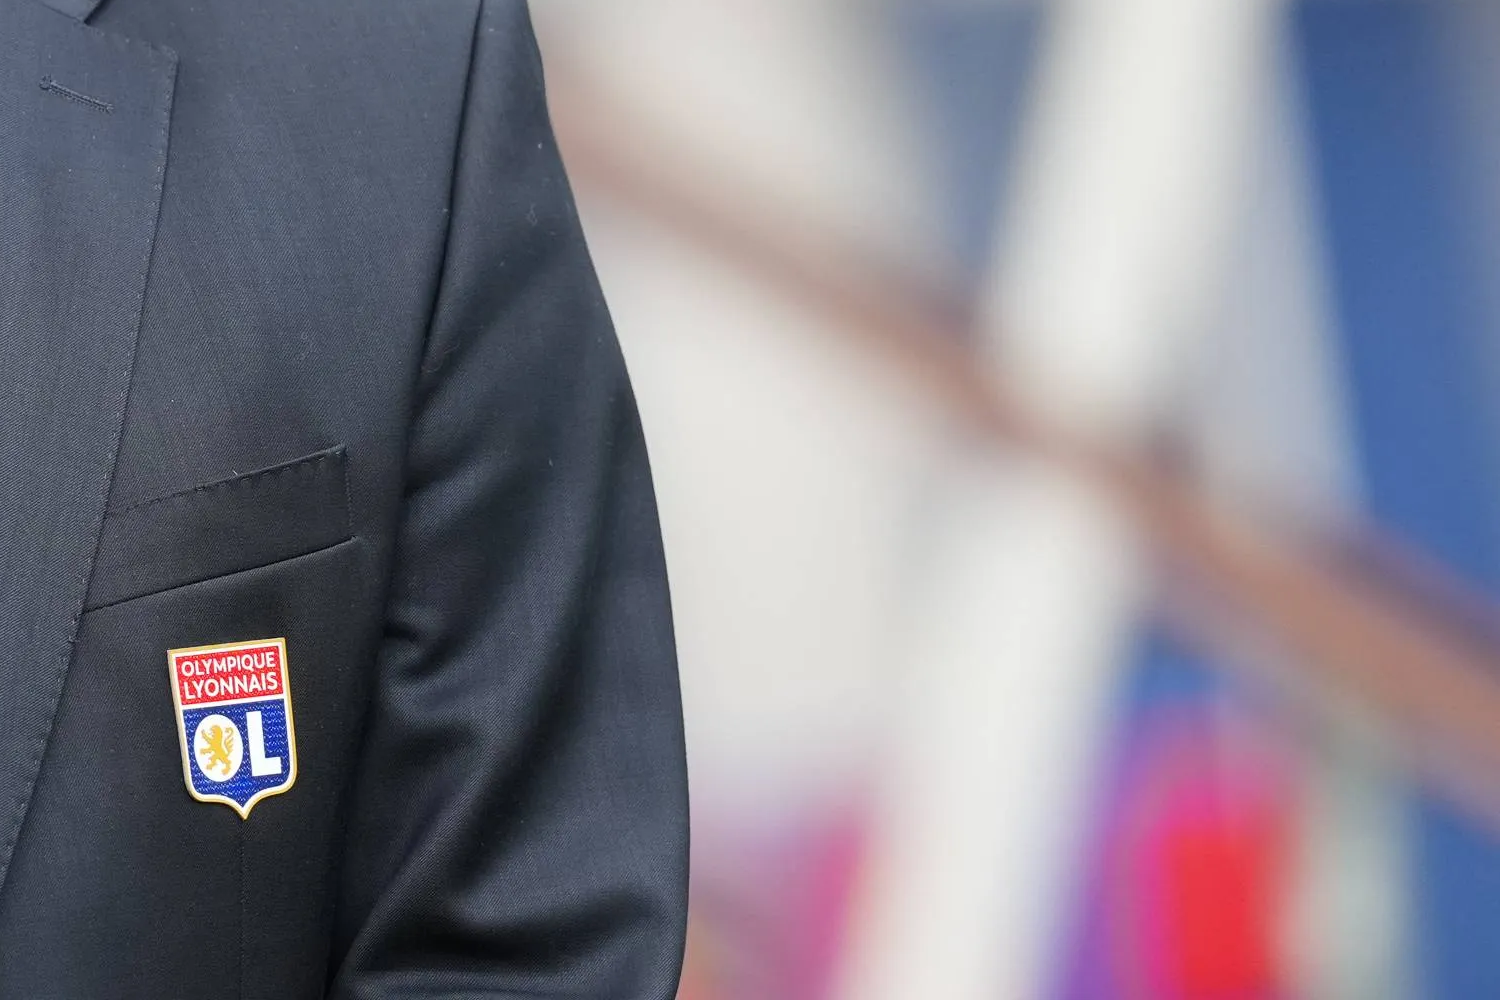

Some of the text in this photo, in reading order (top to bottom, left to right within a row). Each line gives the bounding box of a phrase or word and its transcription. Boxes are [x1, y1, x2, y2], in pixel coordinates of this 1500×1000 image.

[181, 651, 276, 677] OLYMPIQUE
[183, 672, 279, 700] LYONNAIS
[193, 710, 282, 783] OL
